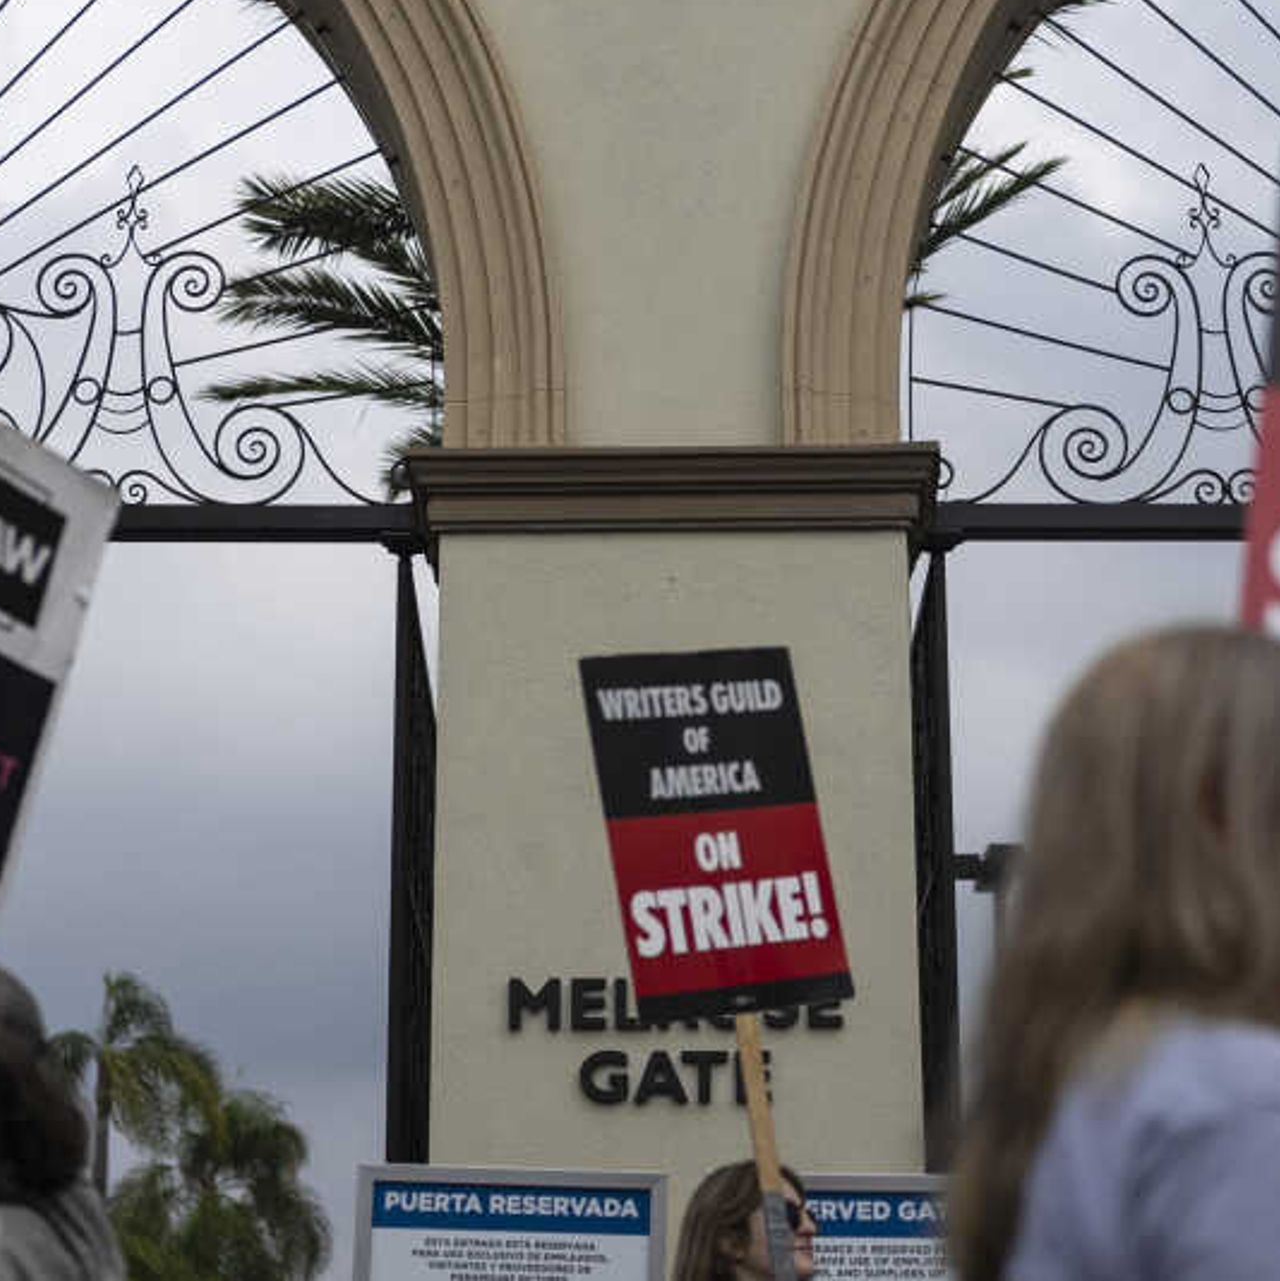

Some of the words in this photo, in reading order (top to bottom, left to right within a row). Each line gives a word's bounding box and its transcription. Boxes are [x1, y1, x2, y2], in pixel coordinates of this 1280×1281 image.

[597, 682, 708, 720] WRITERS
[711, 679, 783, 713] GUILD
[683, 727, 711, 754] OF
[649, 761, 761, 800] AMERICA
[694, 831, 742, 872] ON
[630, 871, 830, 958] STRIKE!
[384, 1190, 482, 1214] PUERTA
[489, 1194, 639, 1218] RESERVADA
